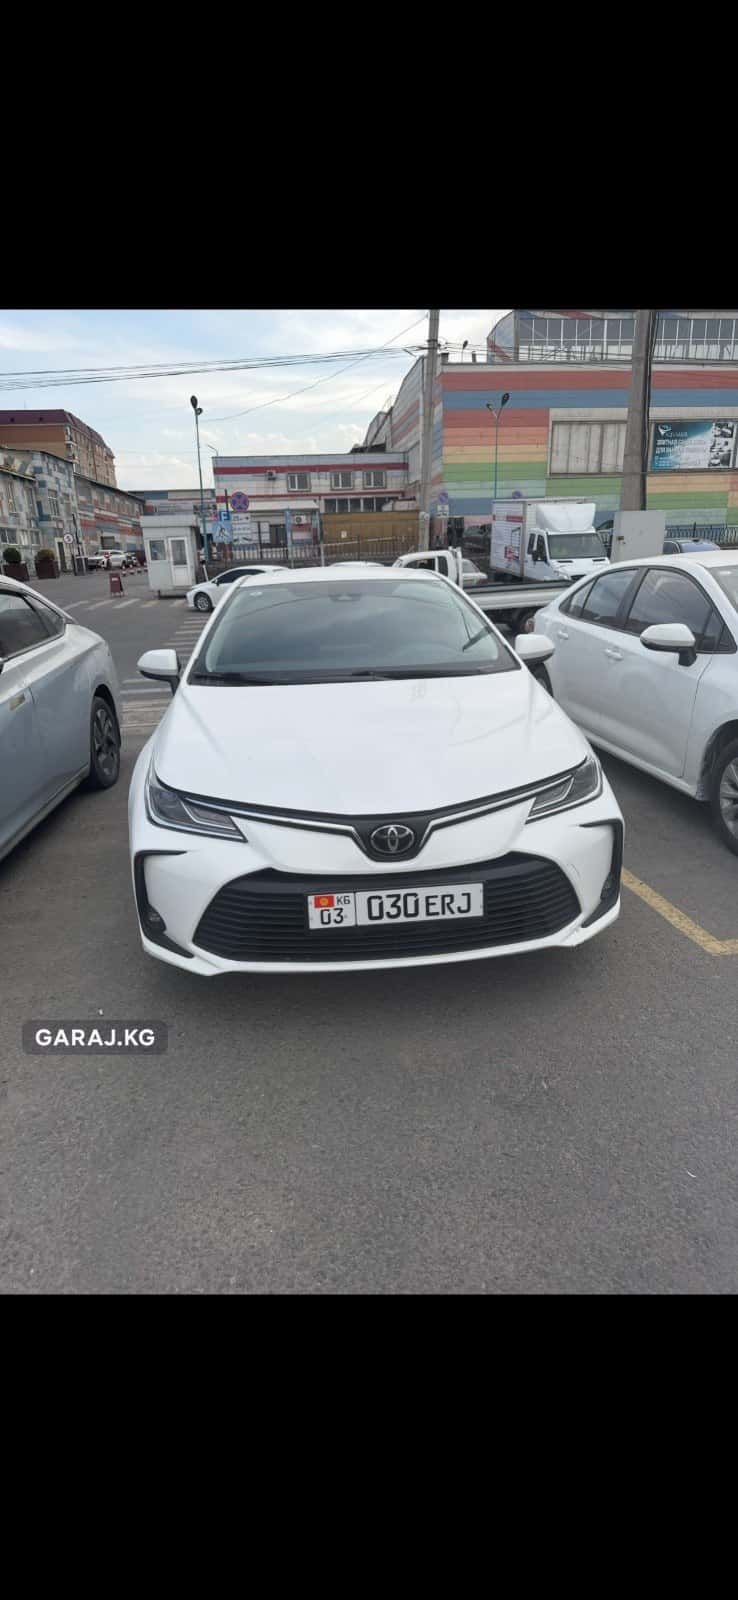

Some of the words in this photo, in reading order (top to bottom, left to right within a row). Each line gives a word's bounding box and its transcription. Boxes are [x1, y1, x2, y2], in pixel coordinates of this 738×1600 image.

[320, 907, 344, 925] 03
[367, 892, 419, 920] 030
[425, 892, 471, 916] ERJ
